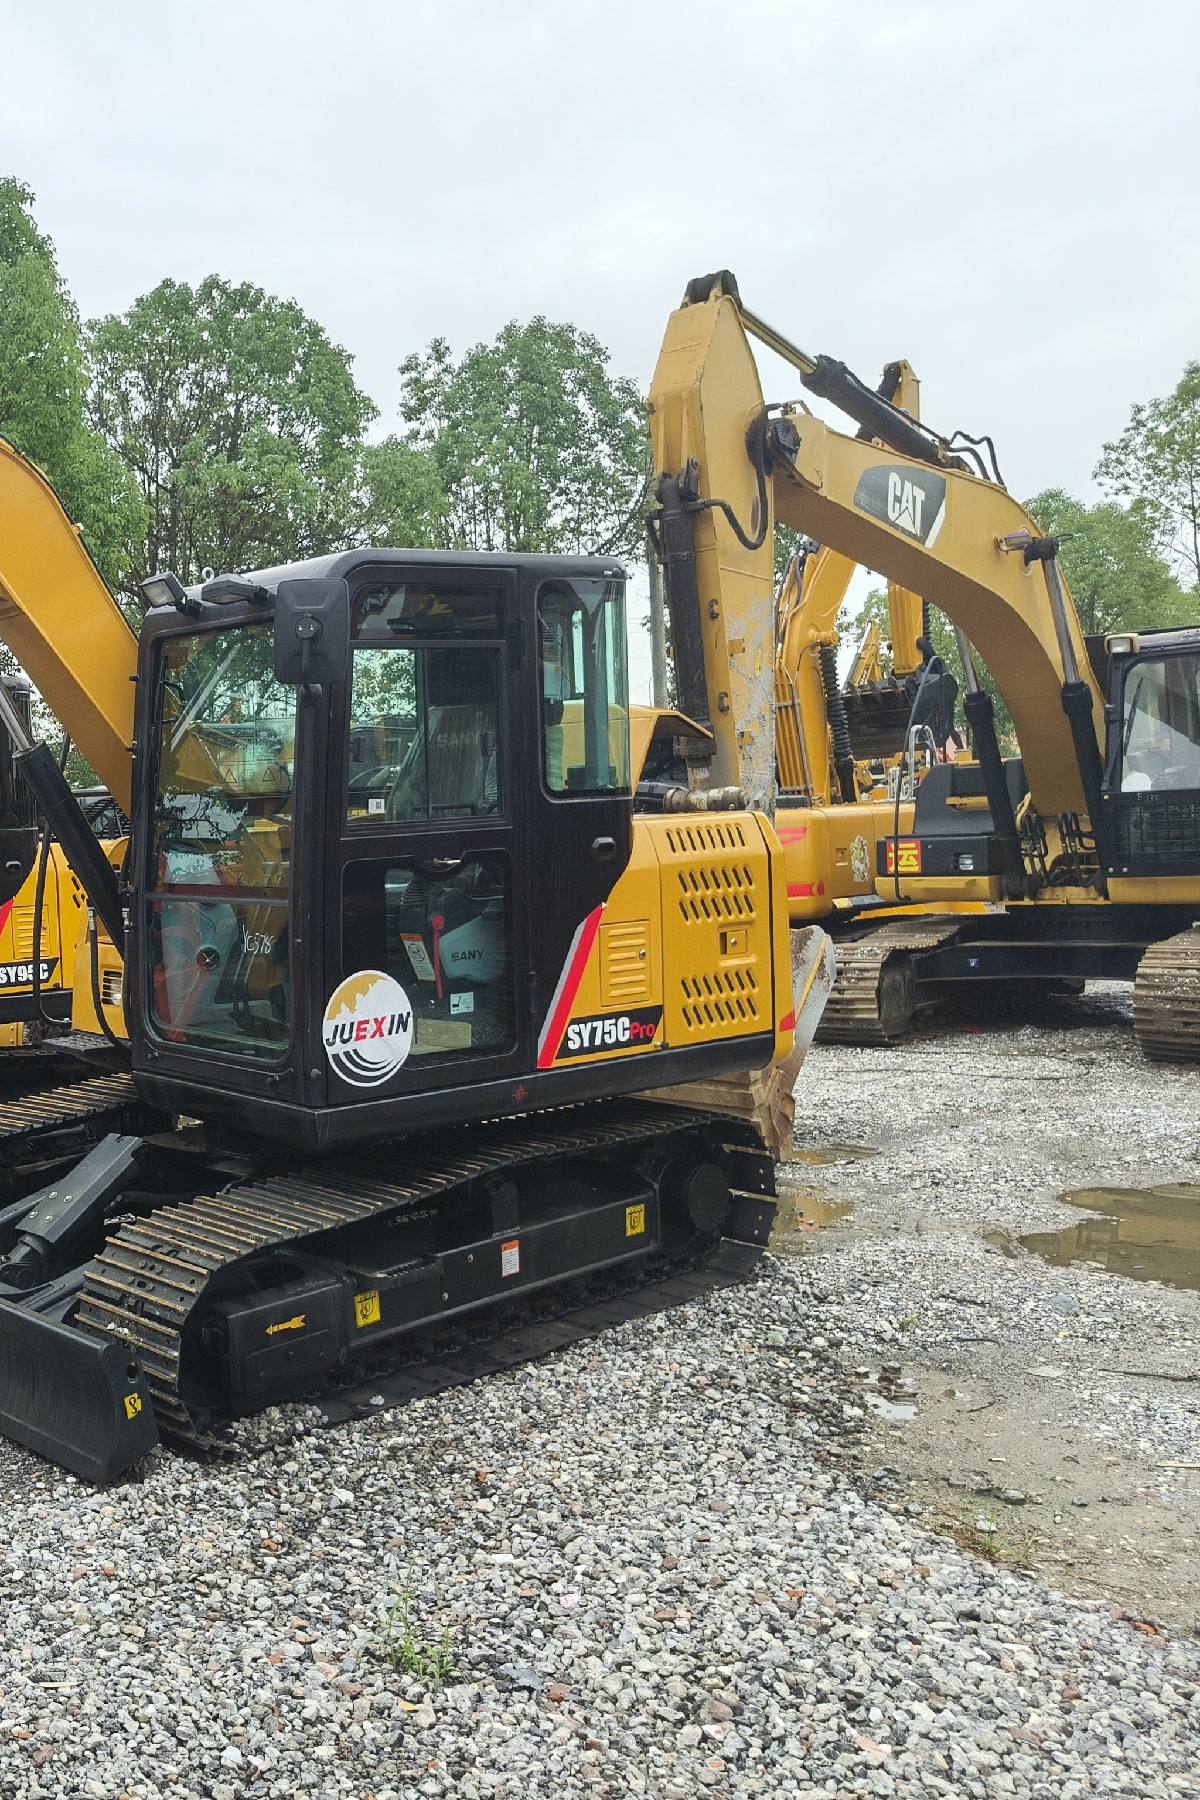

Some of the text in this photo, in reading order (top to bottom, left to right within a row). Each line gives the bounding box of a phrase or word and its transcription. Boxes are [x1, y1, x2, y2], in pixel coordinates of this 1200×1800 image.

[887, 471, 926, 537] CAT
[450, 948, 485, 962] SANY
[325, 1011, 411, 1047] JUEXIN
